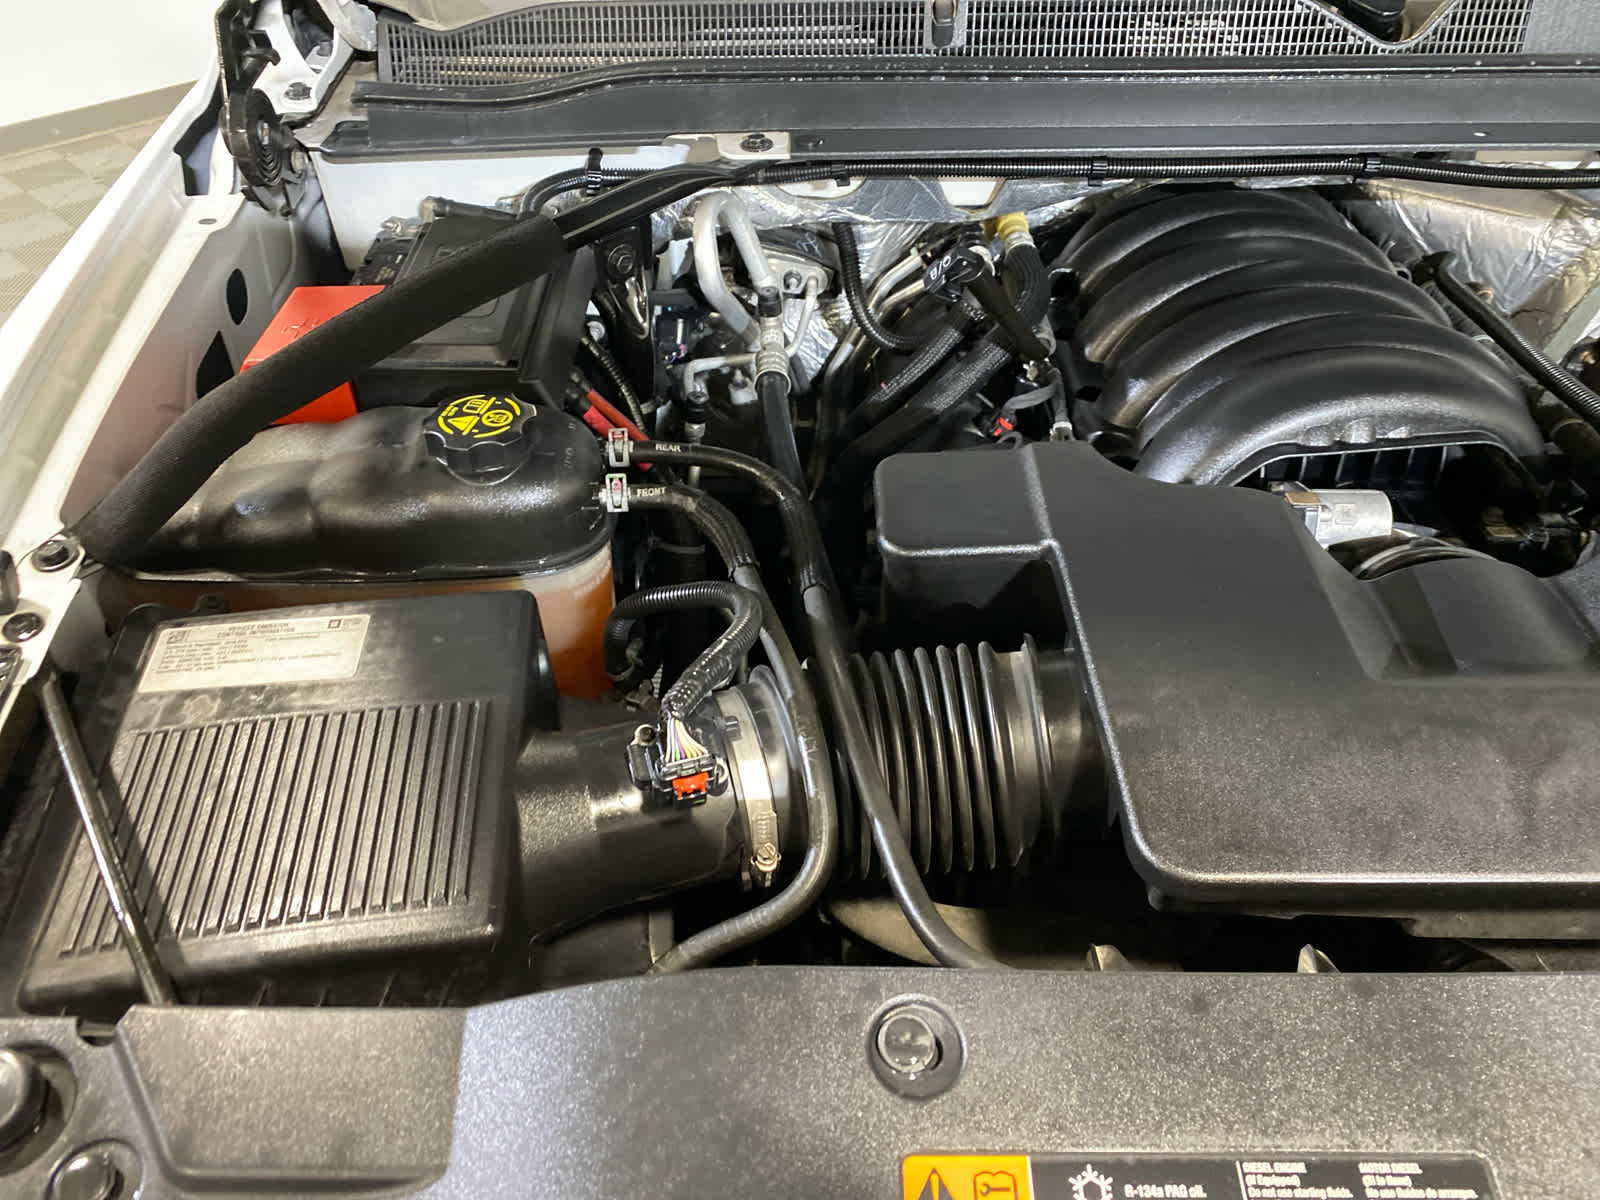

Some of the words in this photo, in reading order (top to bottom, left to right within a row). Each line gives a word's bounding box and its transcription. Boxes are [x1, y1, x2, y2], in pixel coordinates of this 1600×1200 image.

[655, 443, 682, 453] REAR
[636, 487, 667, 497] FRONT
[1124, 1184, 1164, 1198] R-134a
[1164, 1184, 1188, 1198] PAG
